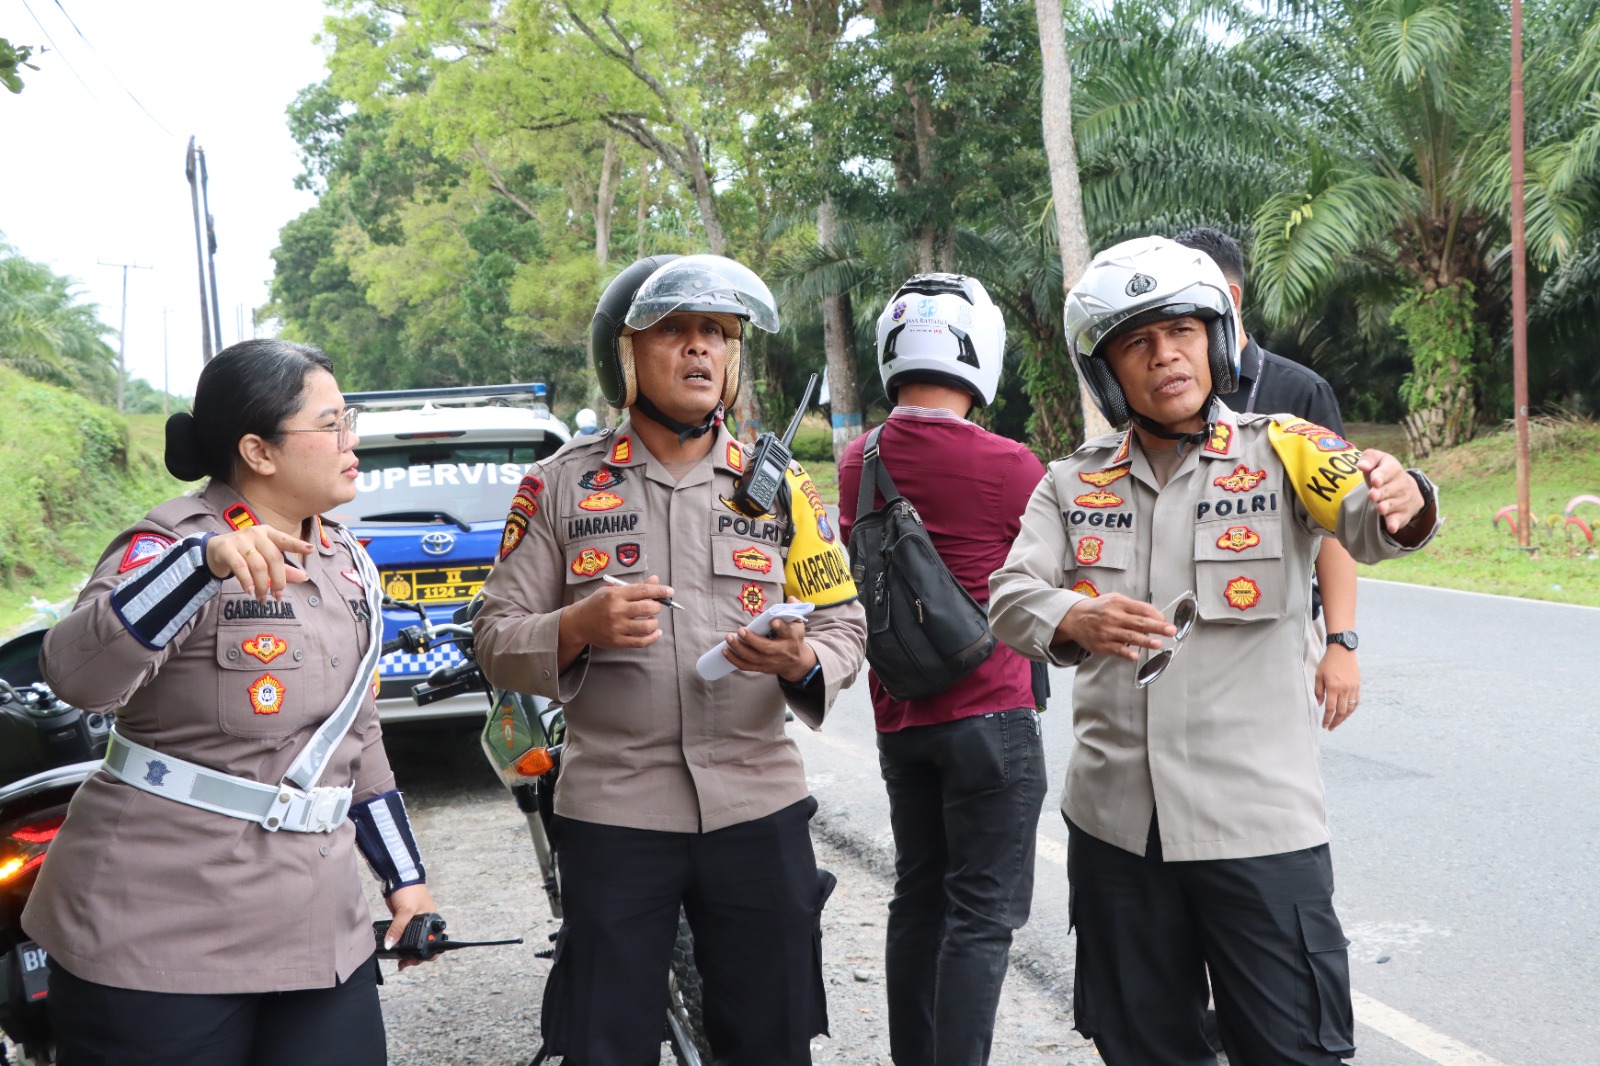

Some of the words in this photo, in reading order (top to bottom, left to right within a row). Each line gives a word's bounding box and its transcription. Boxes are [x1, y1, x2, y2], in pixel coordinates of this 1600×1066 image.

[355, 462, 534, 493] UPERVIS
[1196, 493, 1278, 520] POLRI
[568, 513, 639, 540] I.HARAHAP
[718, 514, 779, 542] POLRI
[424, 586, 456, 599] 1124
